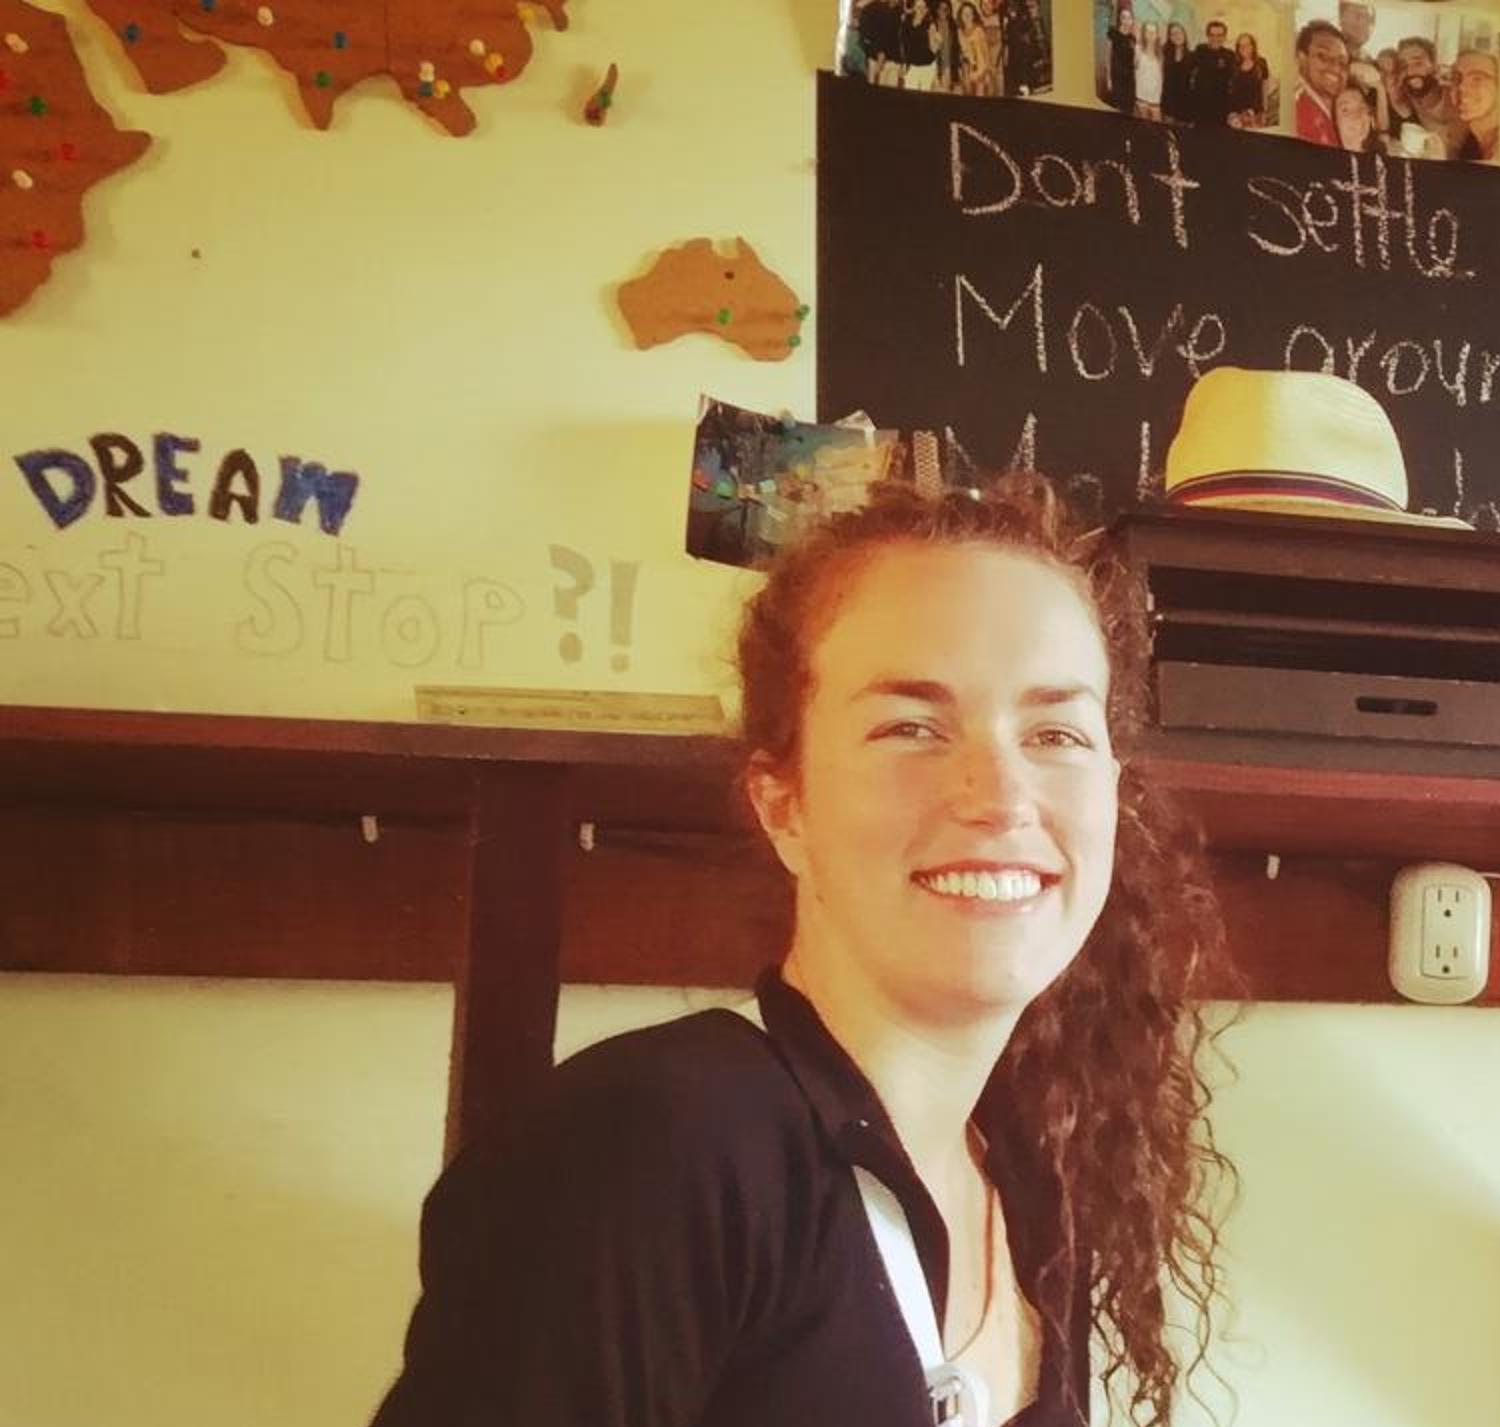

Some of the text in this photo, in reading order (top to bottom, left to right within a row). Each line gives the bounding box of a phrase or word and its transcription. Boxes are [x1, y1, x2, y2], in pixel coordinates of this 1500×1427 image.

[951, 121, 1201, 250] Don't
[1246, 154, 1476, 279] settle
[952, 262, 1228, 381] Move
[13, 432, 361, 537] DREAM
